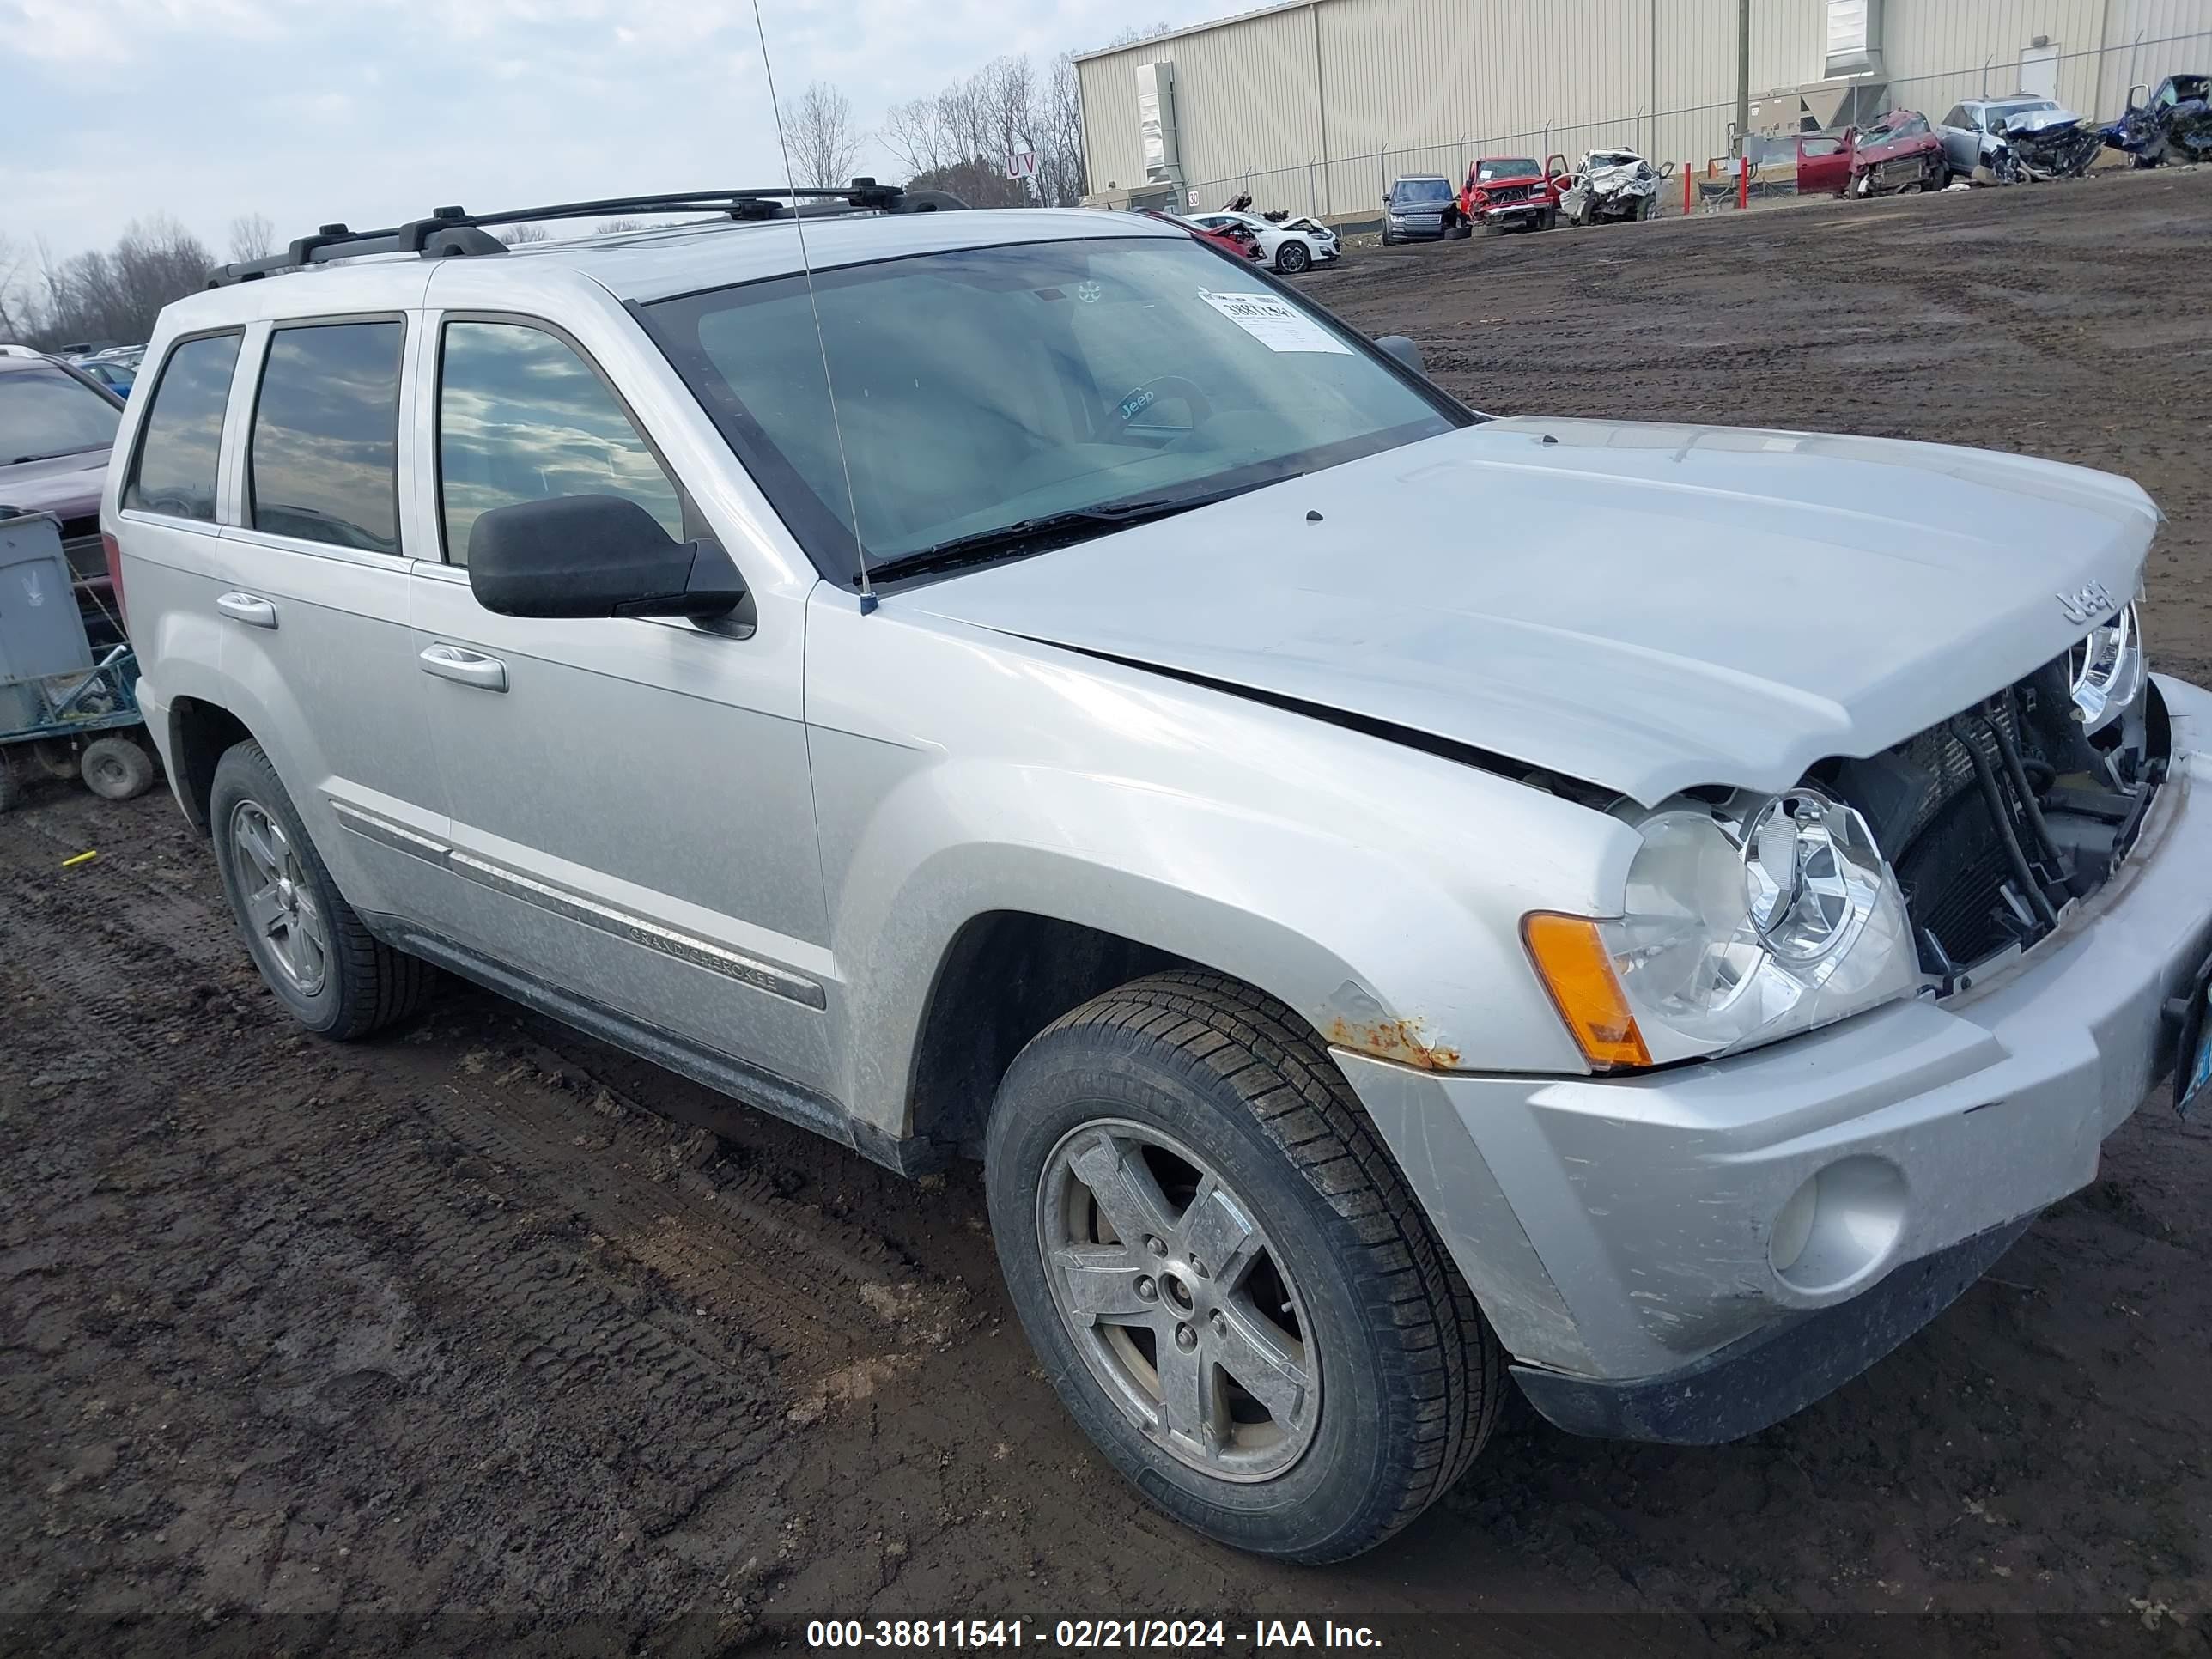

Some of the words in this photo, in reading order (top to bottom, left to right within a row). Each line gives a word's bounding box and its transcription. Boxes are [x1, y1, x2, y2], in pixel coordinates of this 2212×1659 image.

[1189, 193, 1198, 205] 30
[1121, 391, 1154, 420] Jeep
[629, 927, 684, 956] GRAND
[688, 948, 778, 991] CHEROKEE
